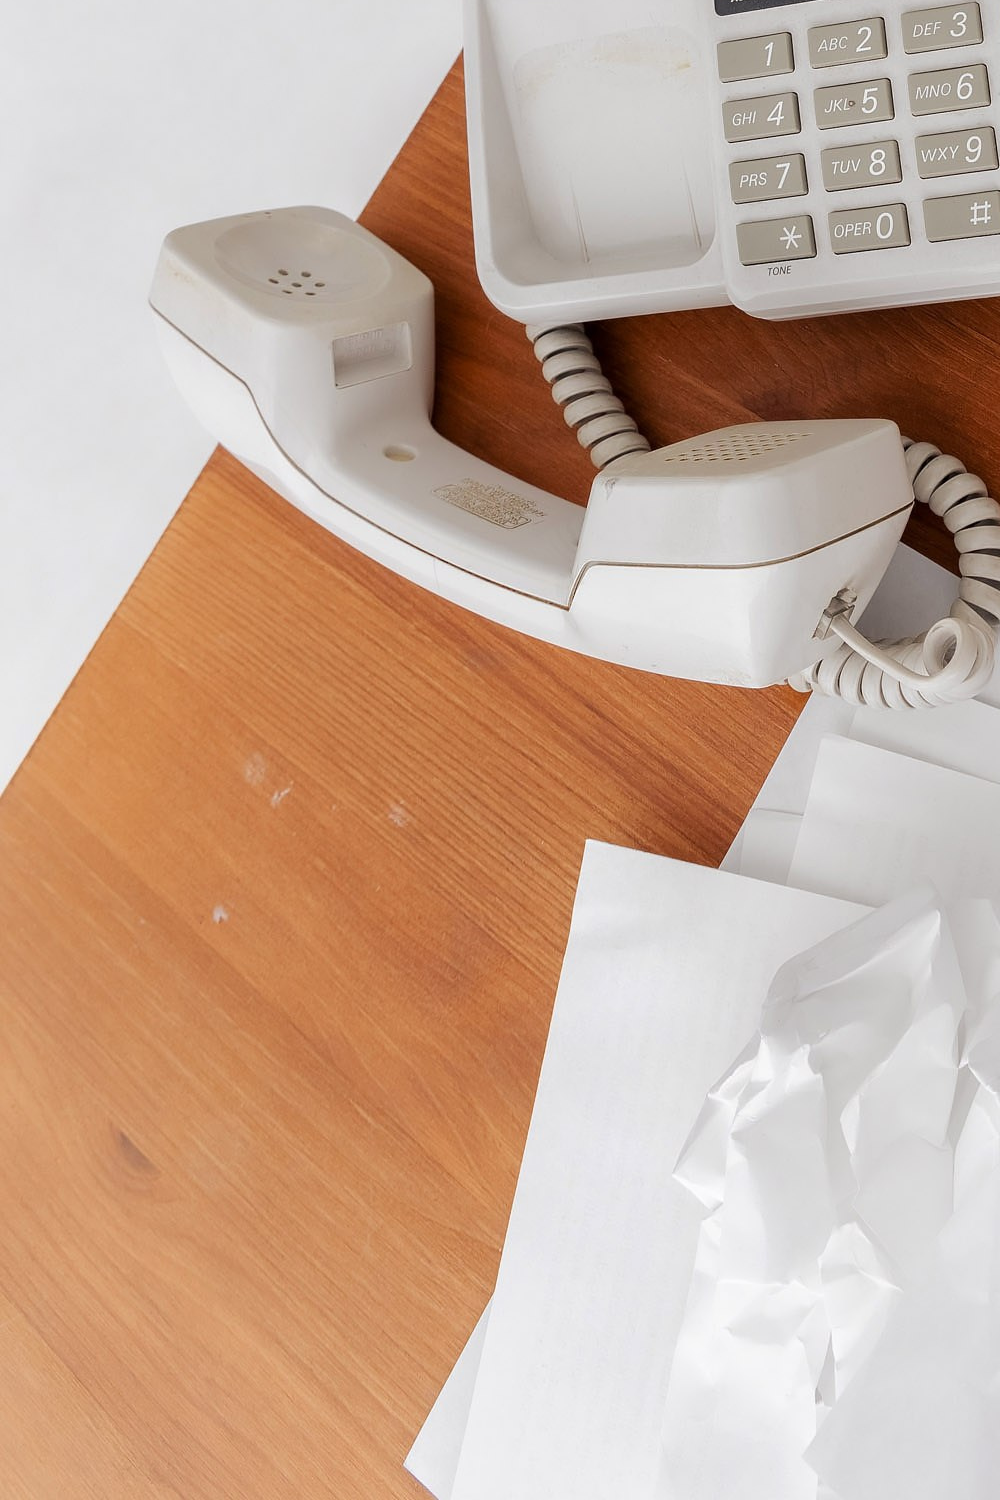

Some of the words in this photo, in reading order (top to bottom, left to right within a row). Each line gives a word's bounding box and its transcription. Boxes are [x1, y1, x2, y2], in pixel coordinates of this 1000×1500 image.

[912, 21, 942, 38] DEF
[950, 12, 968, 37] 3
[818, 36, 848, 52] ABC
[855, 26, 872, 52] 2
[764, 42, 775, 67] 1
[915, 83, 952, 100] MNO
[956, 73, 974, 100] 6
[732, 111, 756, 126] GHI
[767, 101, 784, 126] 4
[824, 98, 850, 113] JKL
[861, 88, 878, 113] 5
[921, 145, 959, 162] WXY
[965, 135, 982, 163] 9
[832, 158, 861, 175] TUV
[869, 150, 886, 175] 8
[739, 173, 767, 188] PRS
[775, 163, 791, 189] 7
[834, 222, 872, 238] OPER
[876, 212, 894, 239] 0
[767, 265, 791, 277] TONE
